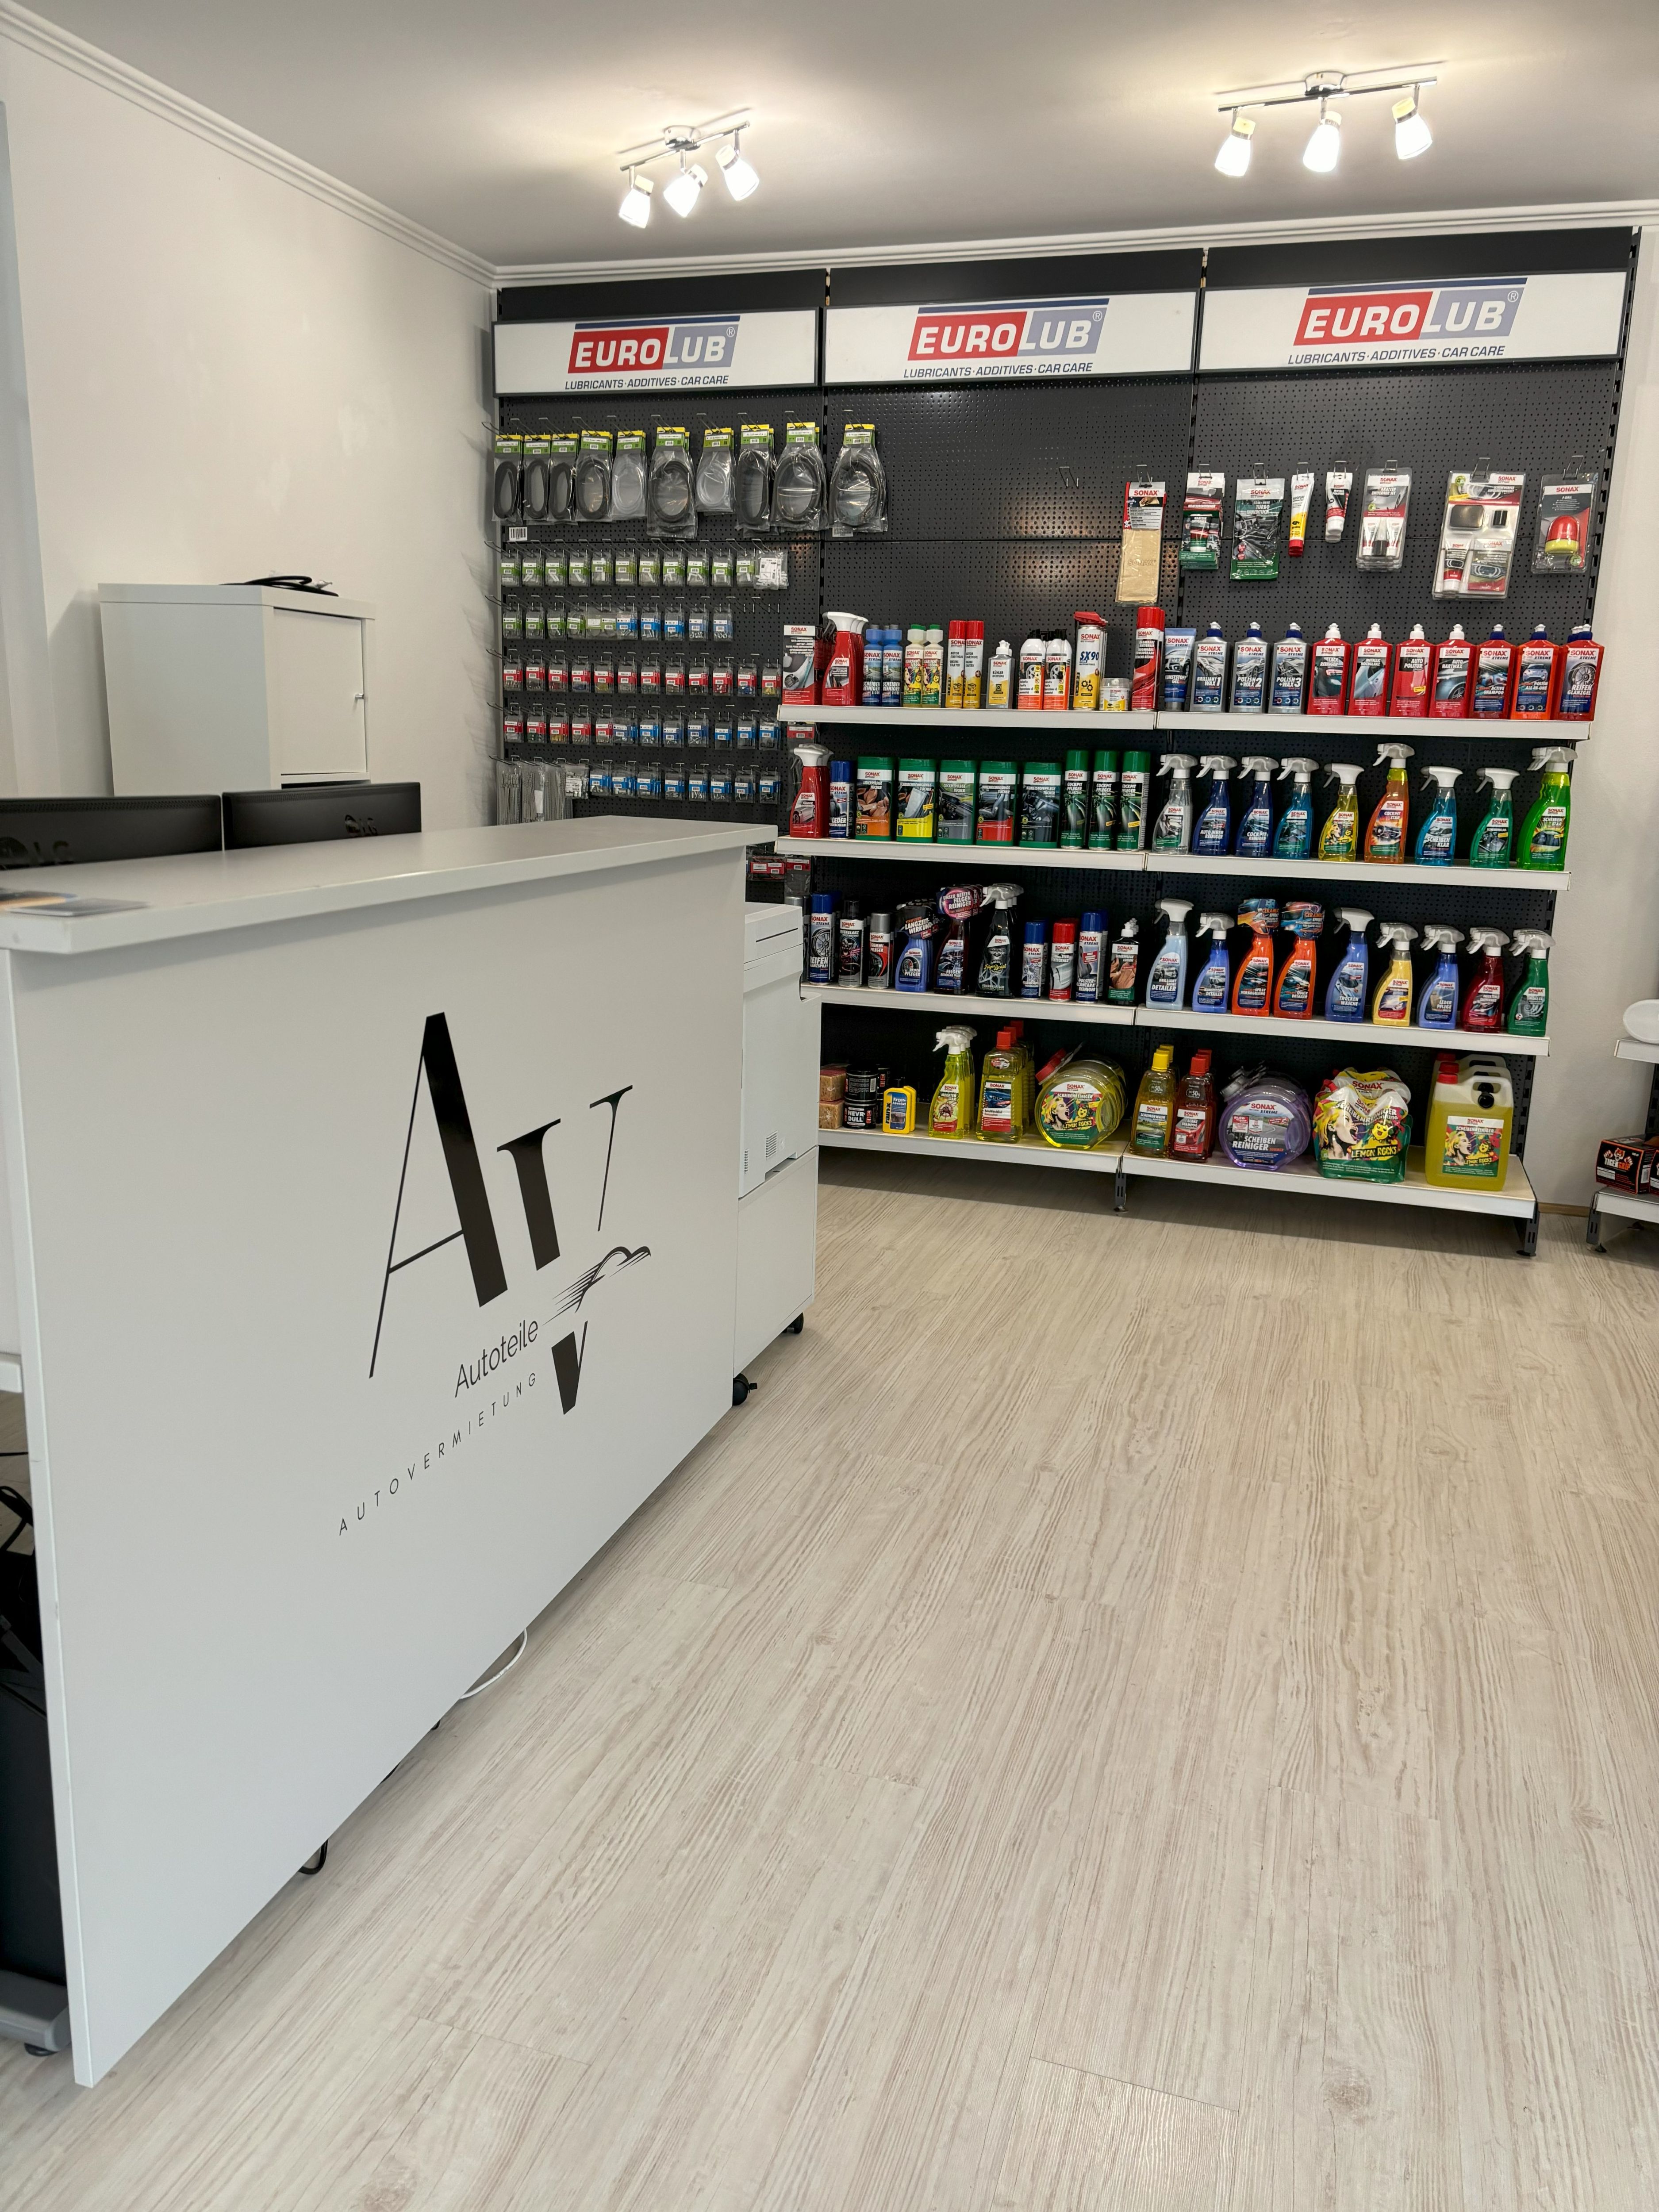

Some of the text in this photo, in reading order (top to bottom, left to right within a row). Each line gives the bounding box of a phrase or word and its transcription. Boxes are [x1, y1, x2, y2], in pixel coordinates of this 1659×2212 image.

[1288, 346, 1505, 365] LUBRICANTS ADDITIVES CAR CARE
[904, 362, 1093, 378] LUBRICANTS ADDITIVES CAR CARE
[565, 375, 729, 390] LUBRICANTS ADDITIVES CAR CARE
[1080, 652, 1099, 661] SX90
[1216, 677, 1221, 686] 1
[1255, 678, 1262, 687] 2
[1294, 678, 1302, 687] 3
[949, 901, 971, 910] REINIGER
[905, 918, 930, 930] LANGZEIT-
[909, 922, 932, 934] WIRKUNG
[1352, 1081, 1382, 1090] SONAX
[1232, 1141, 1269, 1151] REINIGER
[1244, 1136, 1276, 1145] SCHEIBEN
[1351, 1146, 1397, 1158] LEMON ROCKS
[454, 1319, 539, 1398] Autoteile
[338, 1372, 537, 1536] AUTOVERMIETUNG
